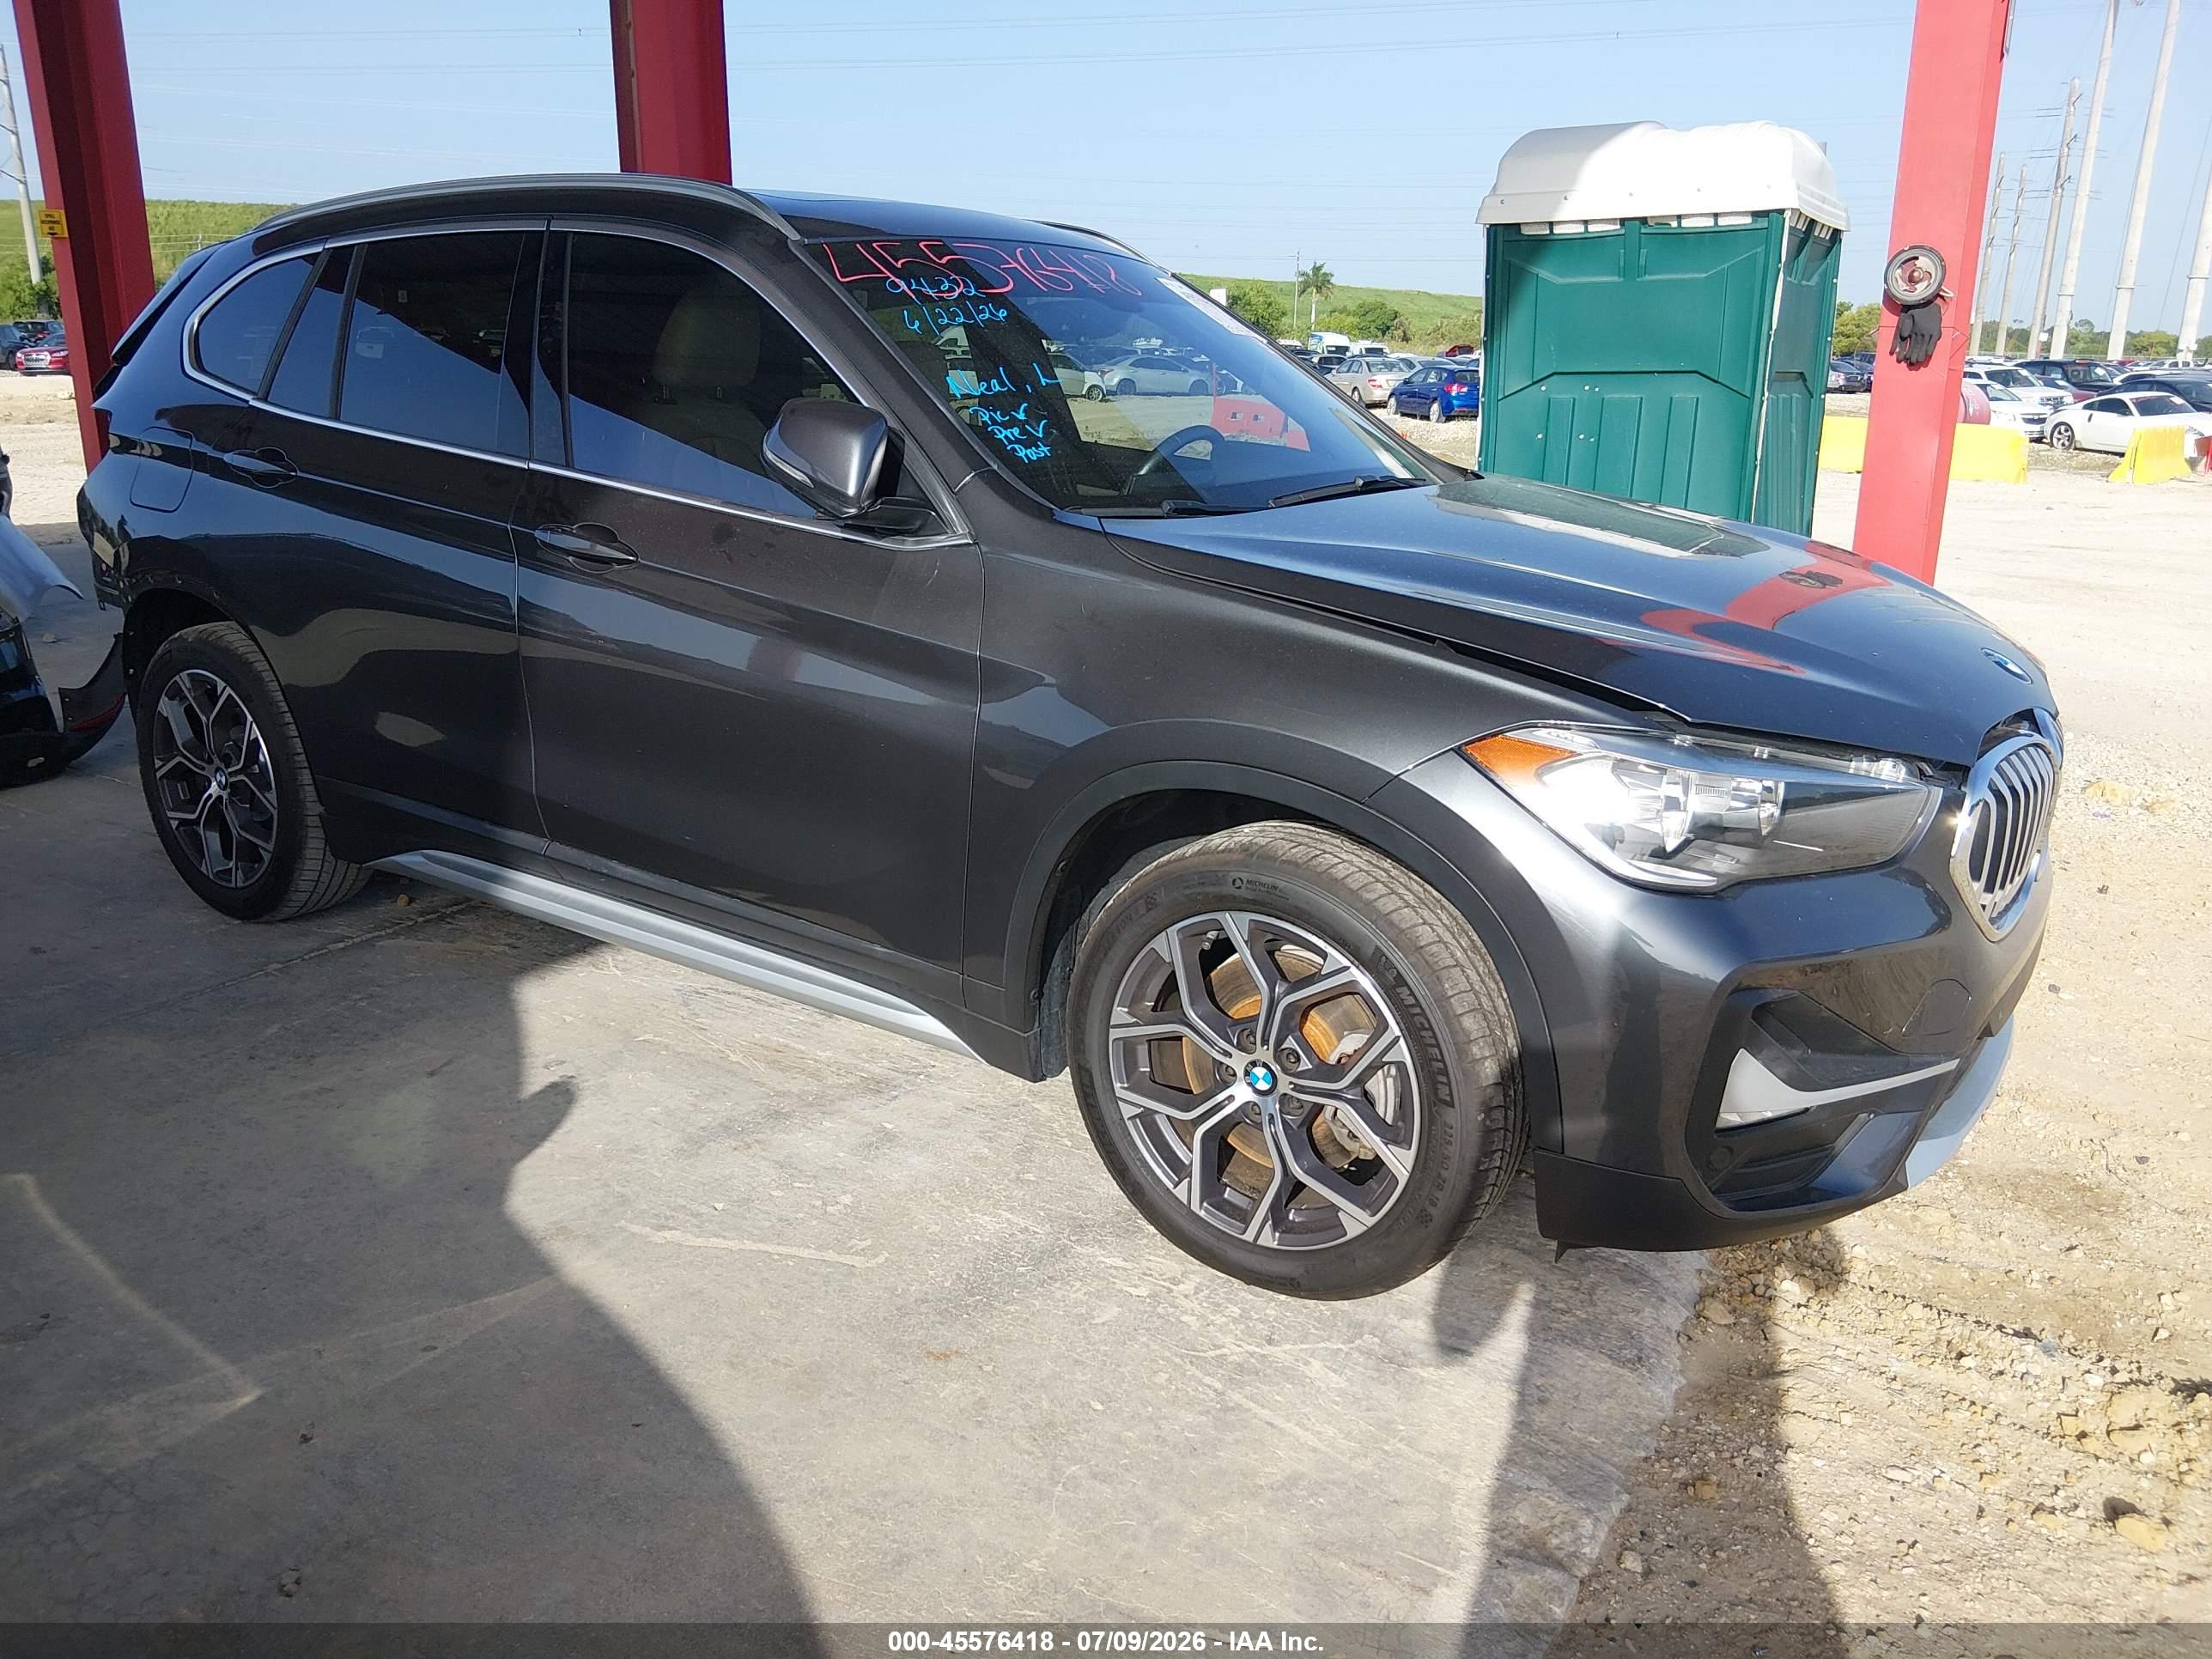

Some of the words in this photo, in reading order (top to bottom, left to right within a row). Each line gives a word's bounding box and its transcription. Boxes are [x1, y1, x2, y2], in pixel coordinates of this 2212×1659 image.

[903, 301, 1008, 336] 6/22/26
[1246, 878, 1279, 891] MICHELIN
[1395, 986, 1455, 1107] MICHELIN
